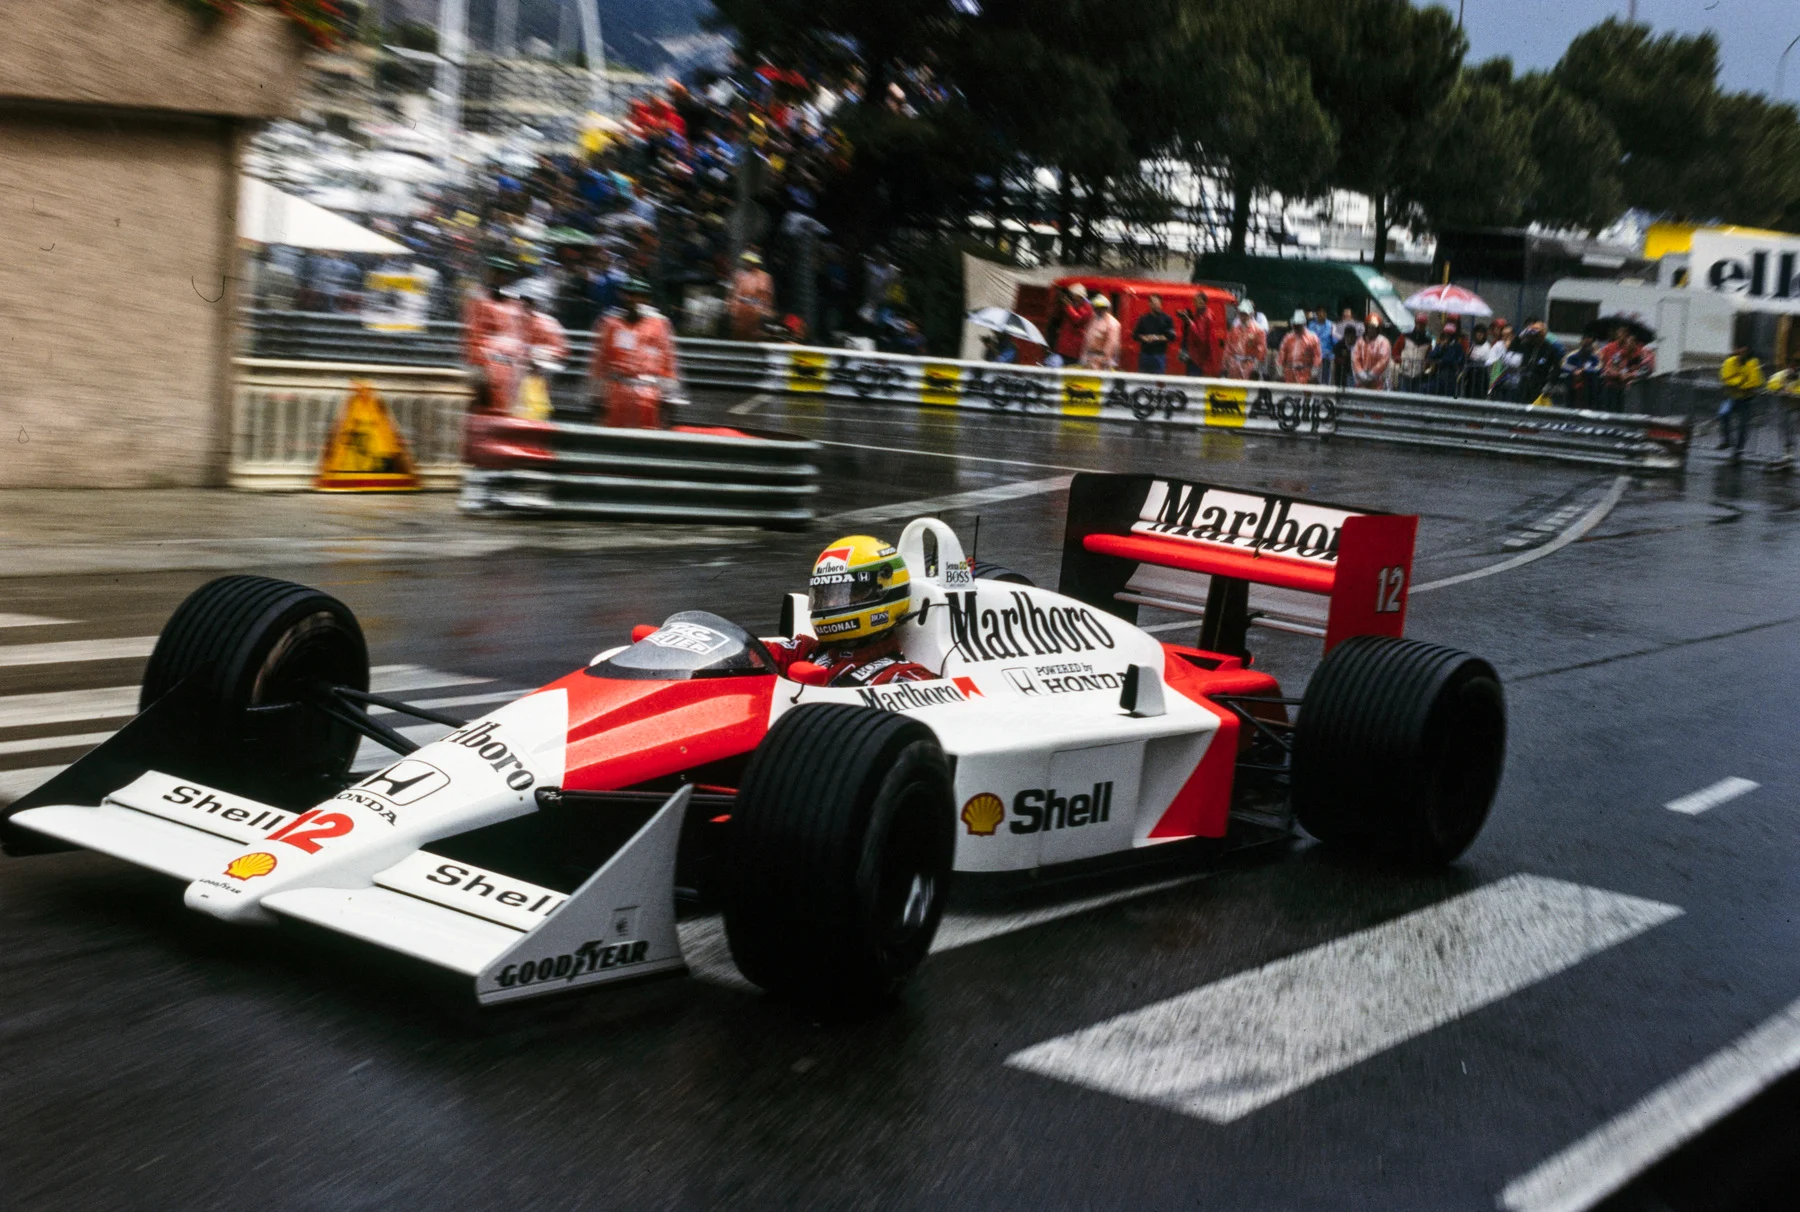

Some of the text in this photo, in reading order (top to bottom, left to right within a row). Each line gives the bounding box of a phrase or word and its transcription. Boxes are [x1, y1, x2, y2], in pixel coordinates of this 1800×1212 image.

[1103, 378, 1188, 421] Agip
[1250, 387, 1336, 433] Agip
[817, 562, 844, 575] Marlboro
[946, 571, 970, 584] BOSS
[1377, 567, 1404, 613] 12
[871, 611, 889, 622] BOSS
[945, 591, 1115, 663] Marlboro
[1035, 662, 1093, 676] POWERED by
[856, 684, 965, 713] Marlboro
[162, 785, 285, 831] Shell
[1009, 781, 1114, 835] Shell
[264, 809, 355, 855] 12
[495, 940, 650, 988] GOODYEAR
